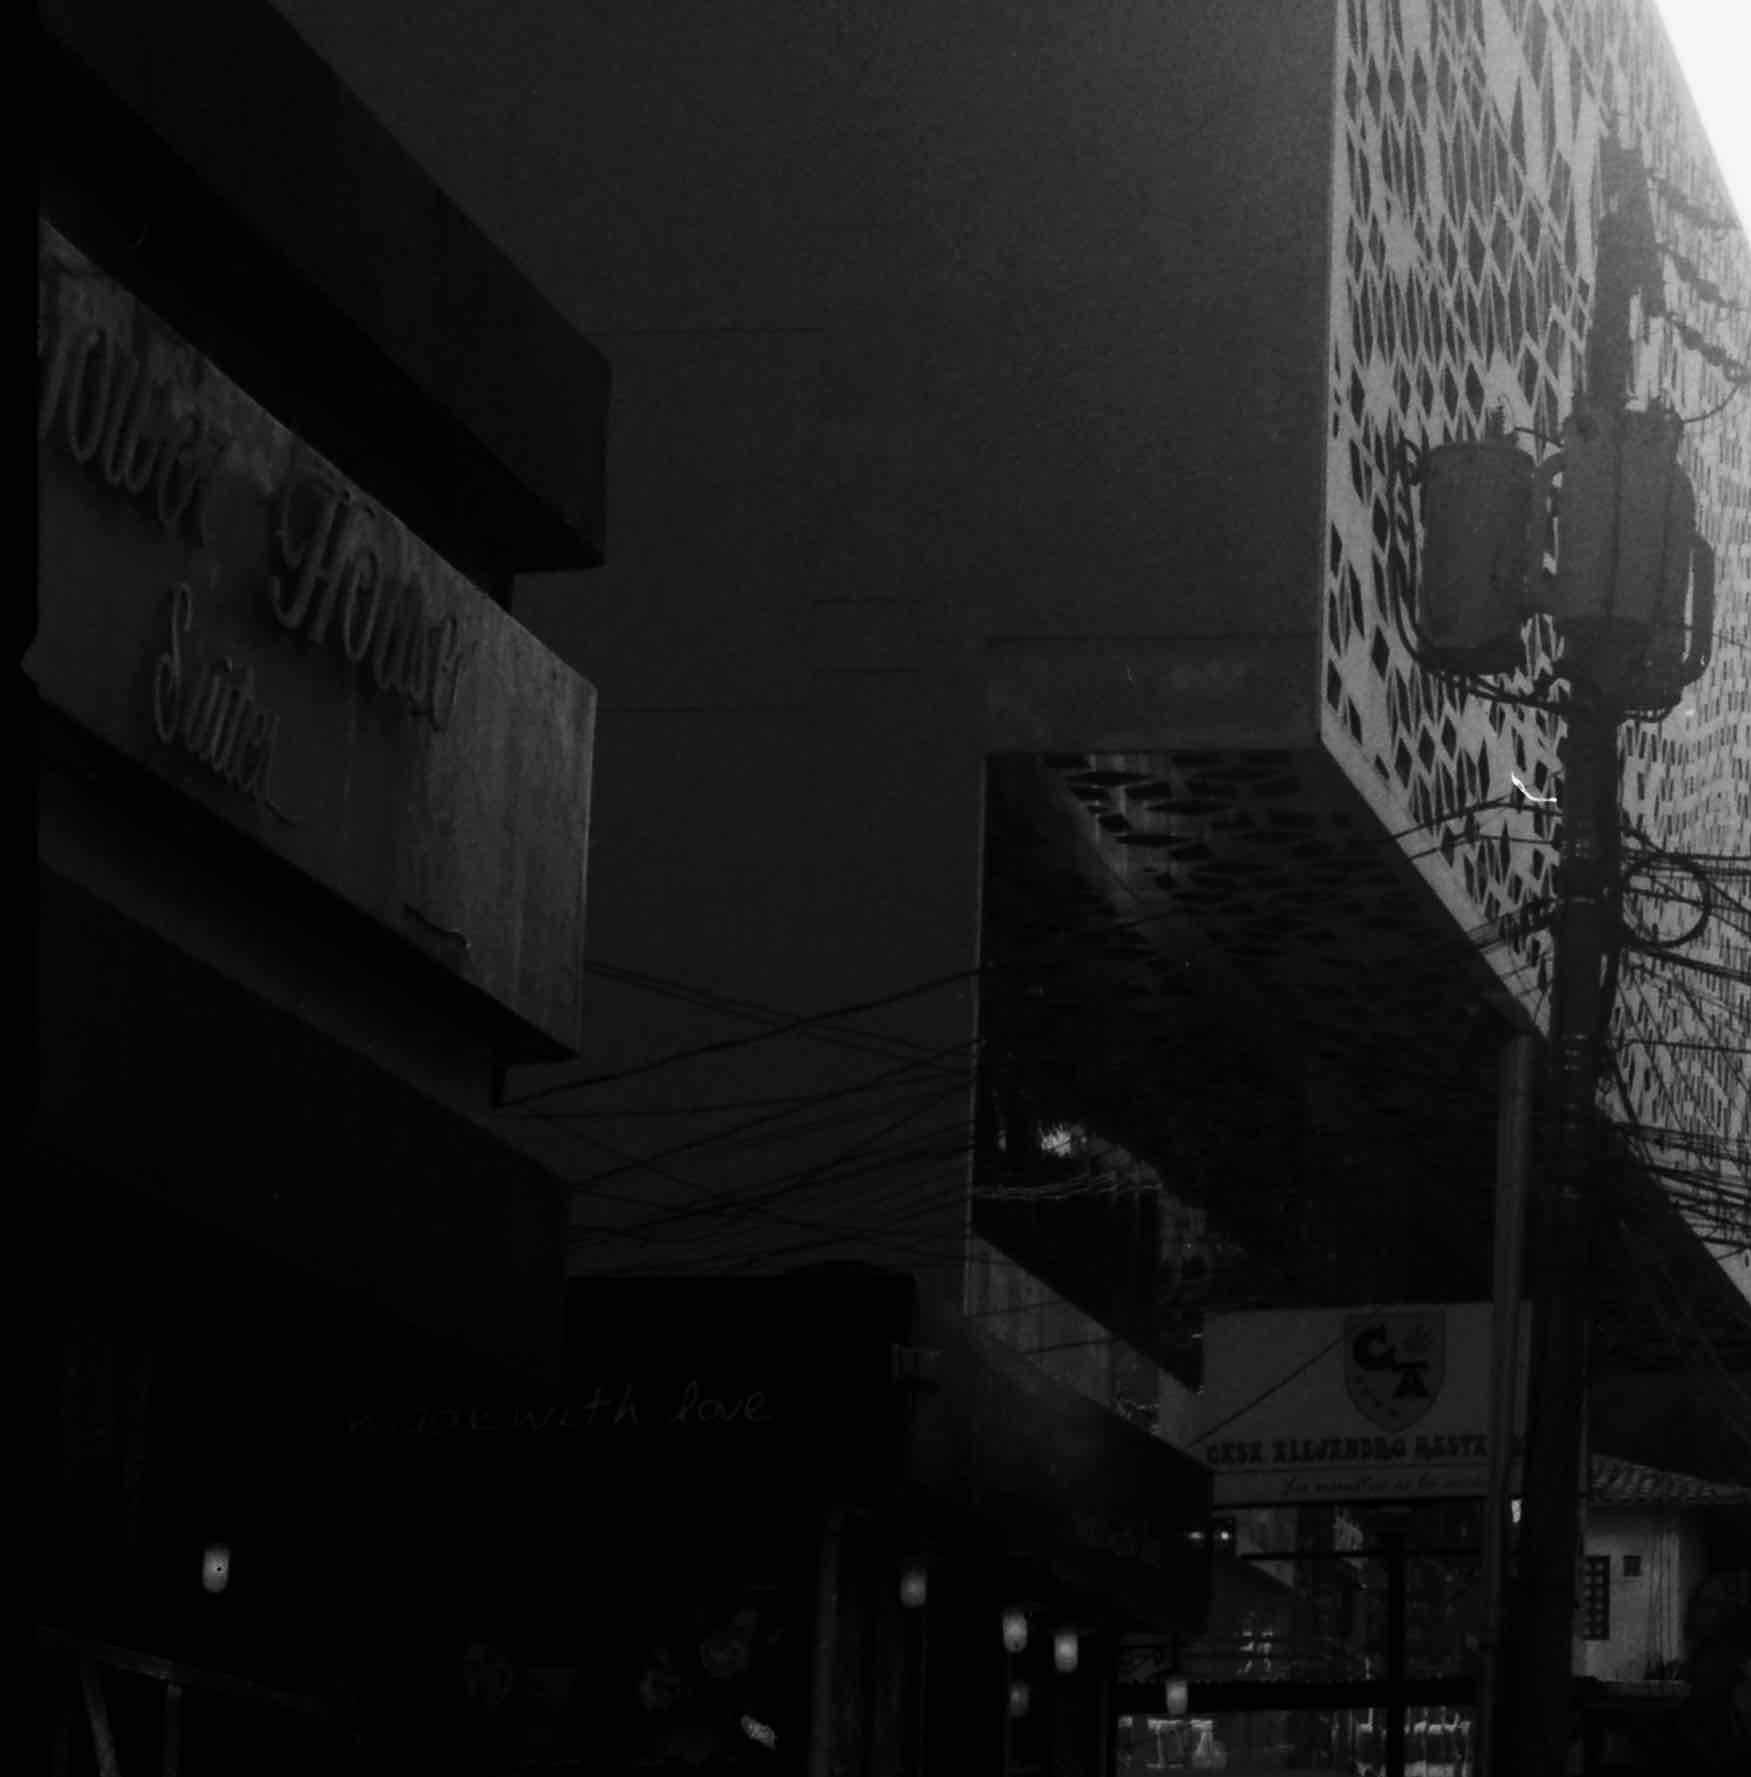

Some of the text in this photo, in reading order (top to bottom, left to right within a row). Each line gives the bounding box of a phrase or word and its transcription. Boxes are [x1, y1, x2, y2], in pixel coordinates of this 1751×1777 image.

[669, 1379, 773, 1424] love
[1207, 1441, 1262, 1465] CASA
[1272, 1437, 1407, 1463] ALEJANDRO
